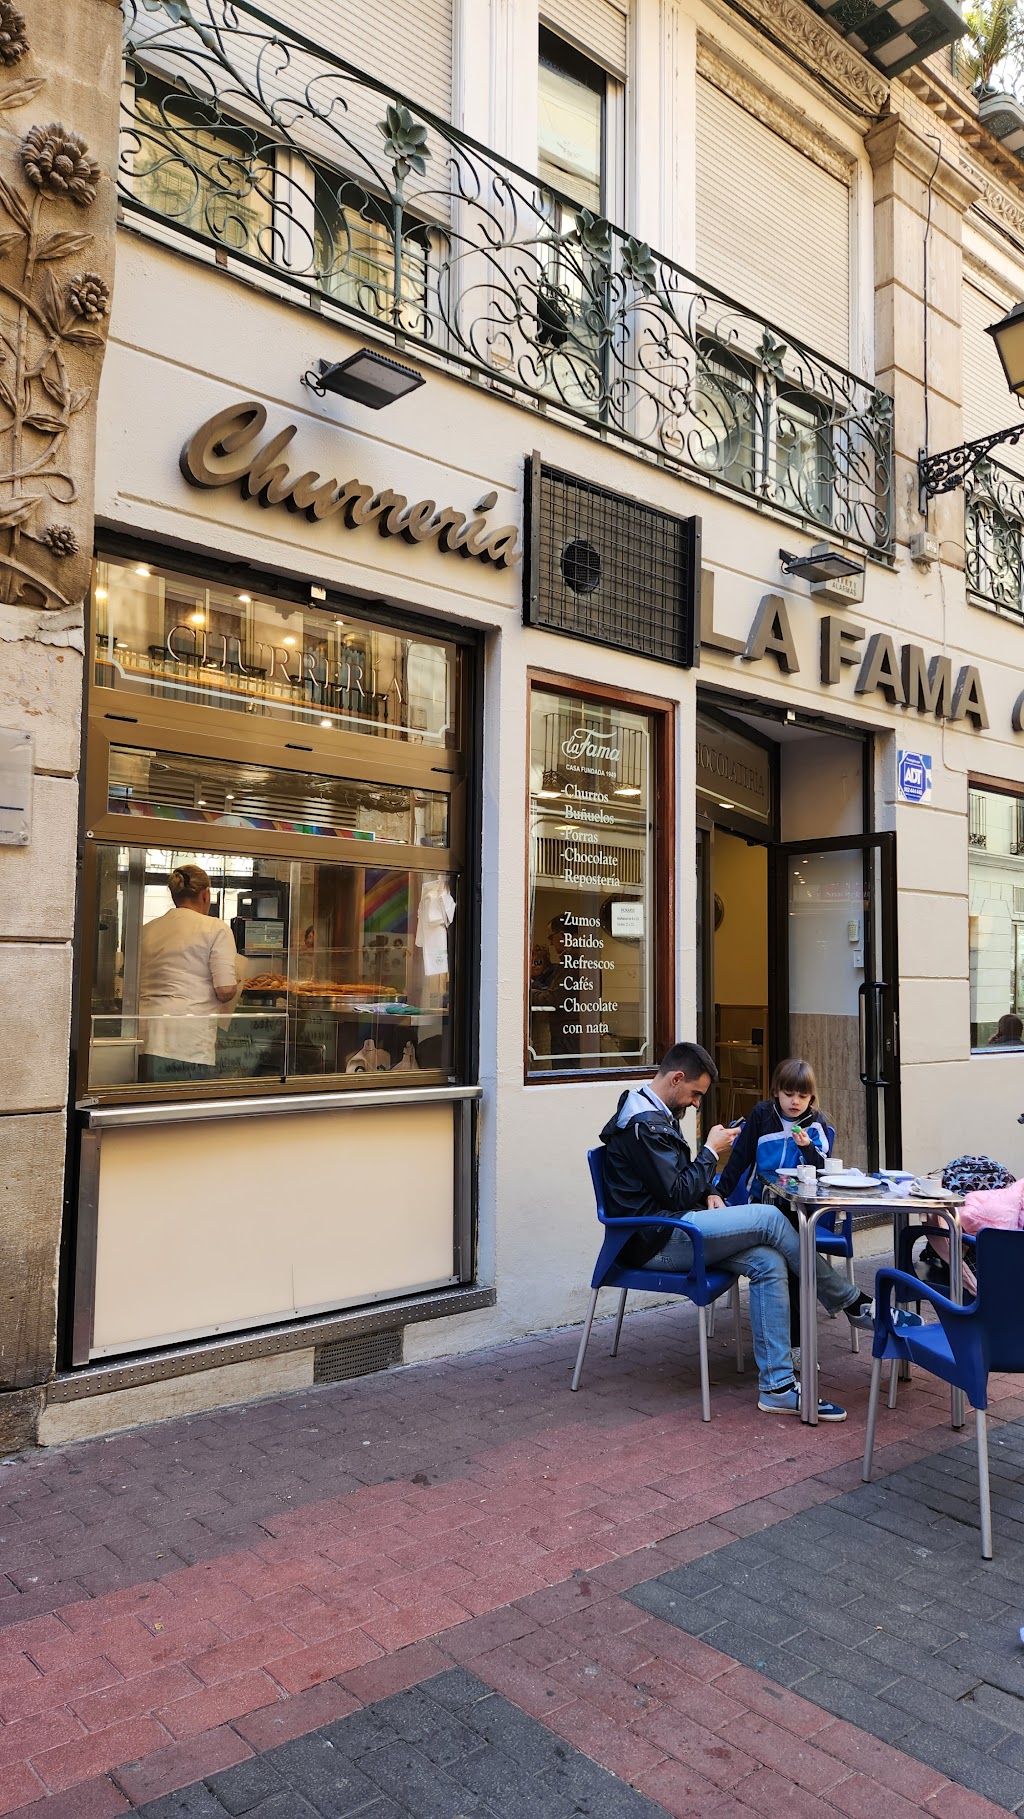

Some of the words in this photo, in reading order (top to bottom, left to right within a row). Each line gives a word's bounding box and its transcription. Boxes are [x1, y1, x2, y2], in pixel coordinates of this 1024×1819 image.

[179, 401, 523, 569] Churrería
[700, 567, 800, 674] LA
[820, 615, 990, 731] FAMA
[573, 728, 621, 762] Fama
[565, 763, 581, 773] CASA
[581, 766, 606, 777] FUNDADA
[904, 766, 923, 785] ADT
[560, 783, 609, 803] -Churros
[560, 827, 599, 843] -Porras
[560, 847, 618, 866] -Chocolate
[560, 868, 620, 887] -Repostería
[560, 911, 601, 928] -Zumos
[559, 932, 604, 949] -Batidos
[559, 954, 615, 970] -Refrescos
[559, 975, 594, 991] -Cafés
[559, 997, 618, 1013] -Chocolate
[562, 1023, 583, 1034] con
[586, 1021, 609, 1034] nata
